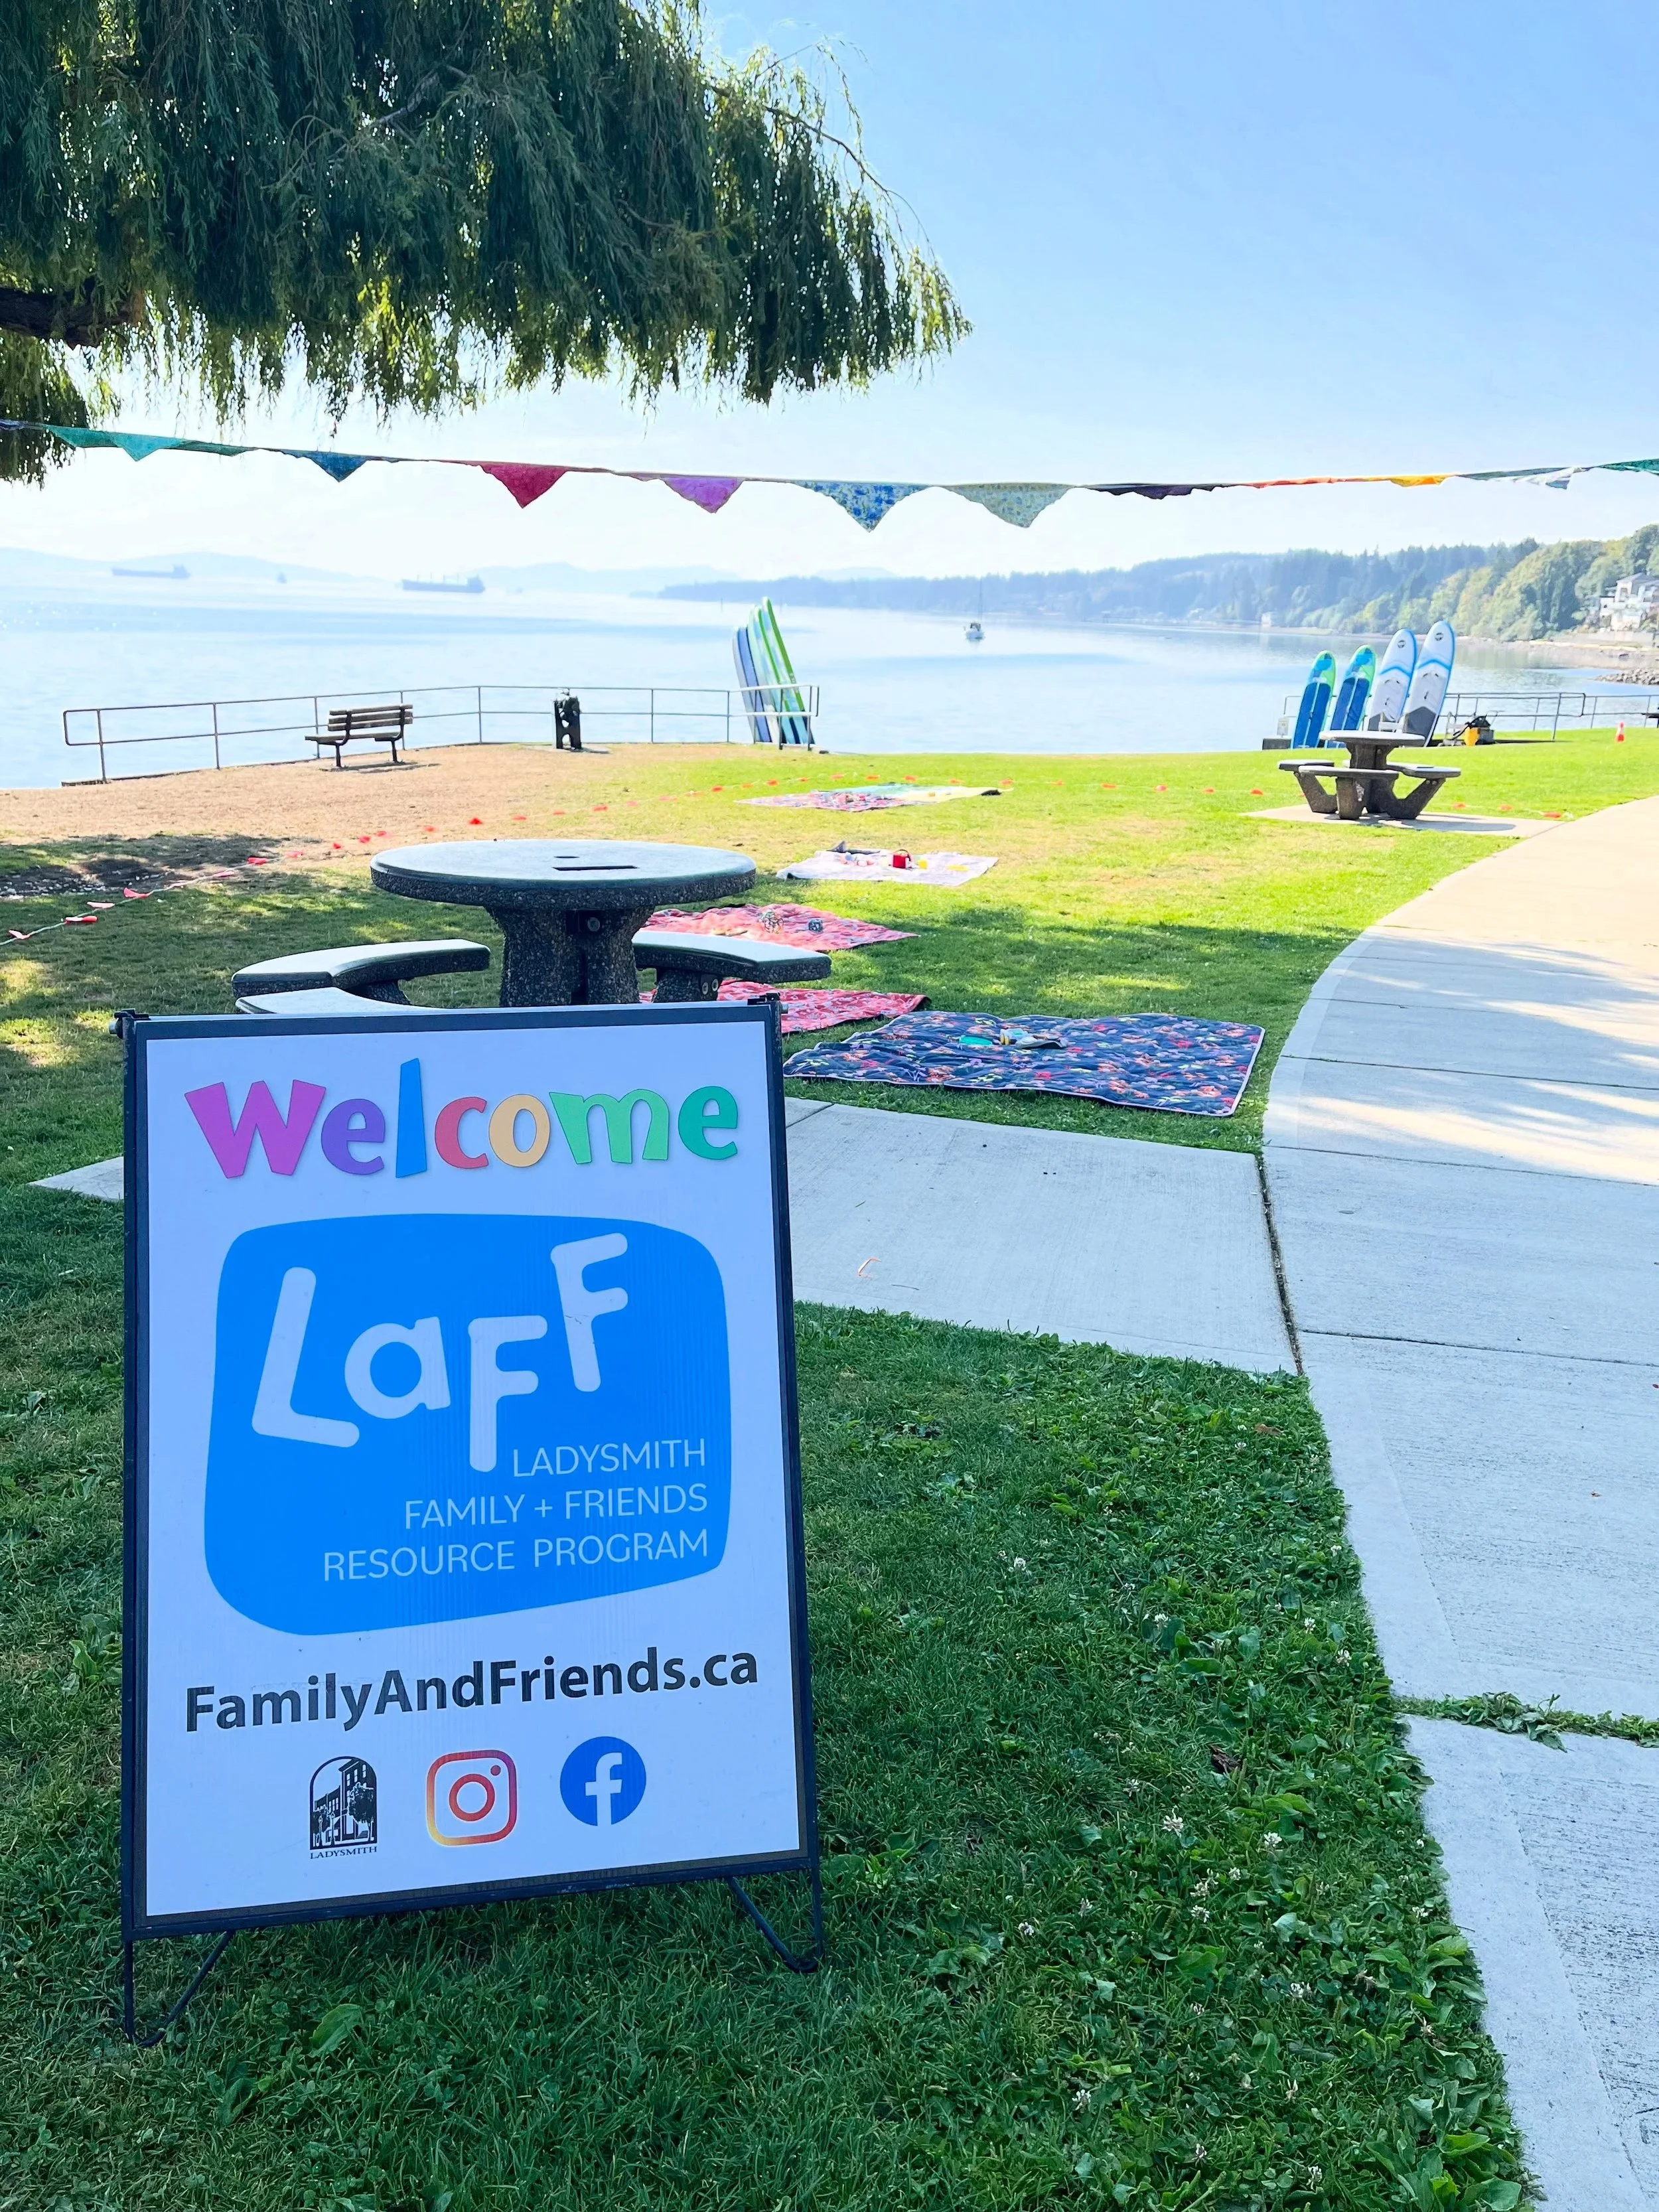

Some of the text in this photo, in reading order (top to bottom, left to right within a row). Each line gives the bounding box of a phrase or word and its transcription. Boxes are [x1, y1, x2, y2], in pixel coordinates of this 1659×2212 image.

[184, 1058, 739, 1179] Welcome
[514, 1439, 705, 1477] LADYSMITH
[405, 1483, 708, 1529] FAMILY + FRIENDS
[325, 1528, 707, 1581] RESOURCE PROGRAM
[186, 1647, 758, 1732] FamilyAndFriends.ca
[310, 1846, 378, 1859] LADYSMITH
